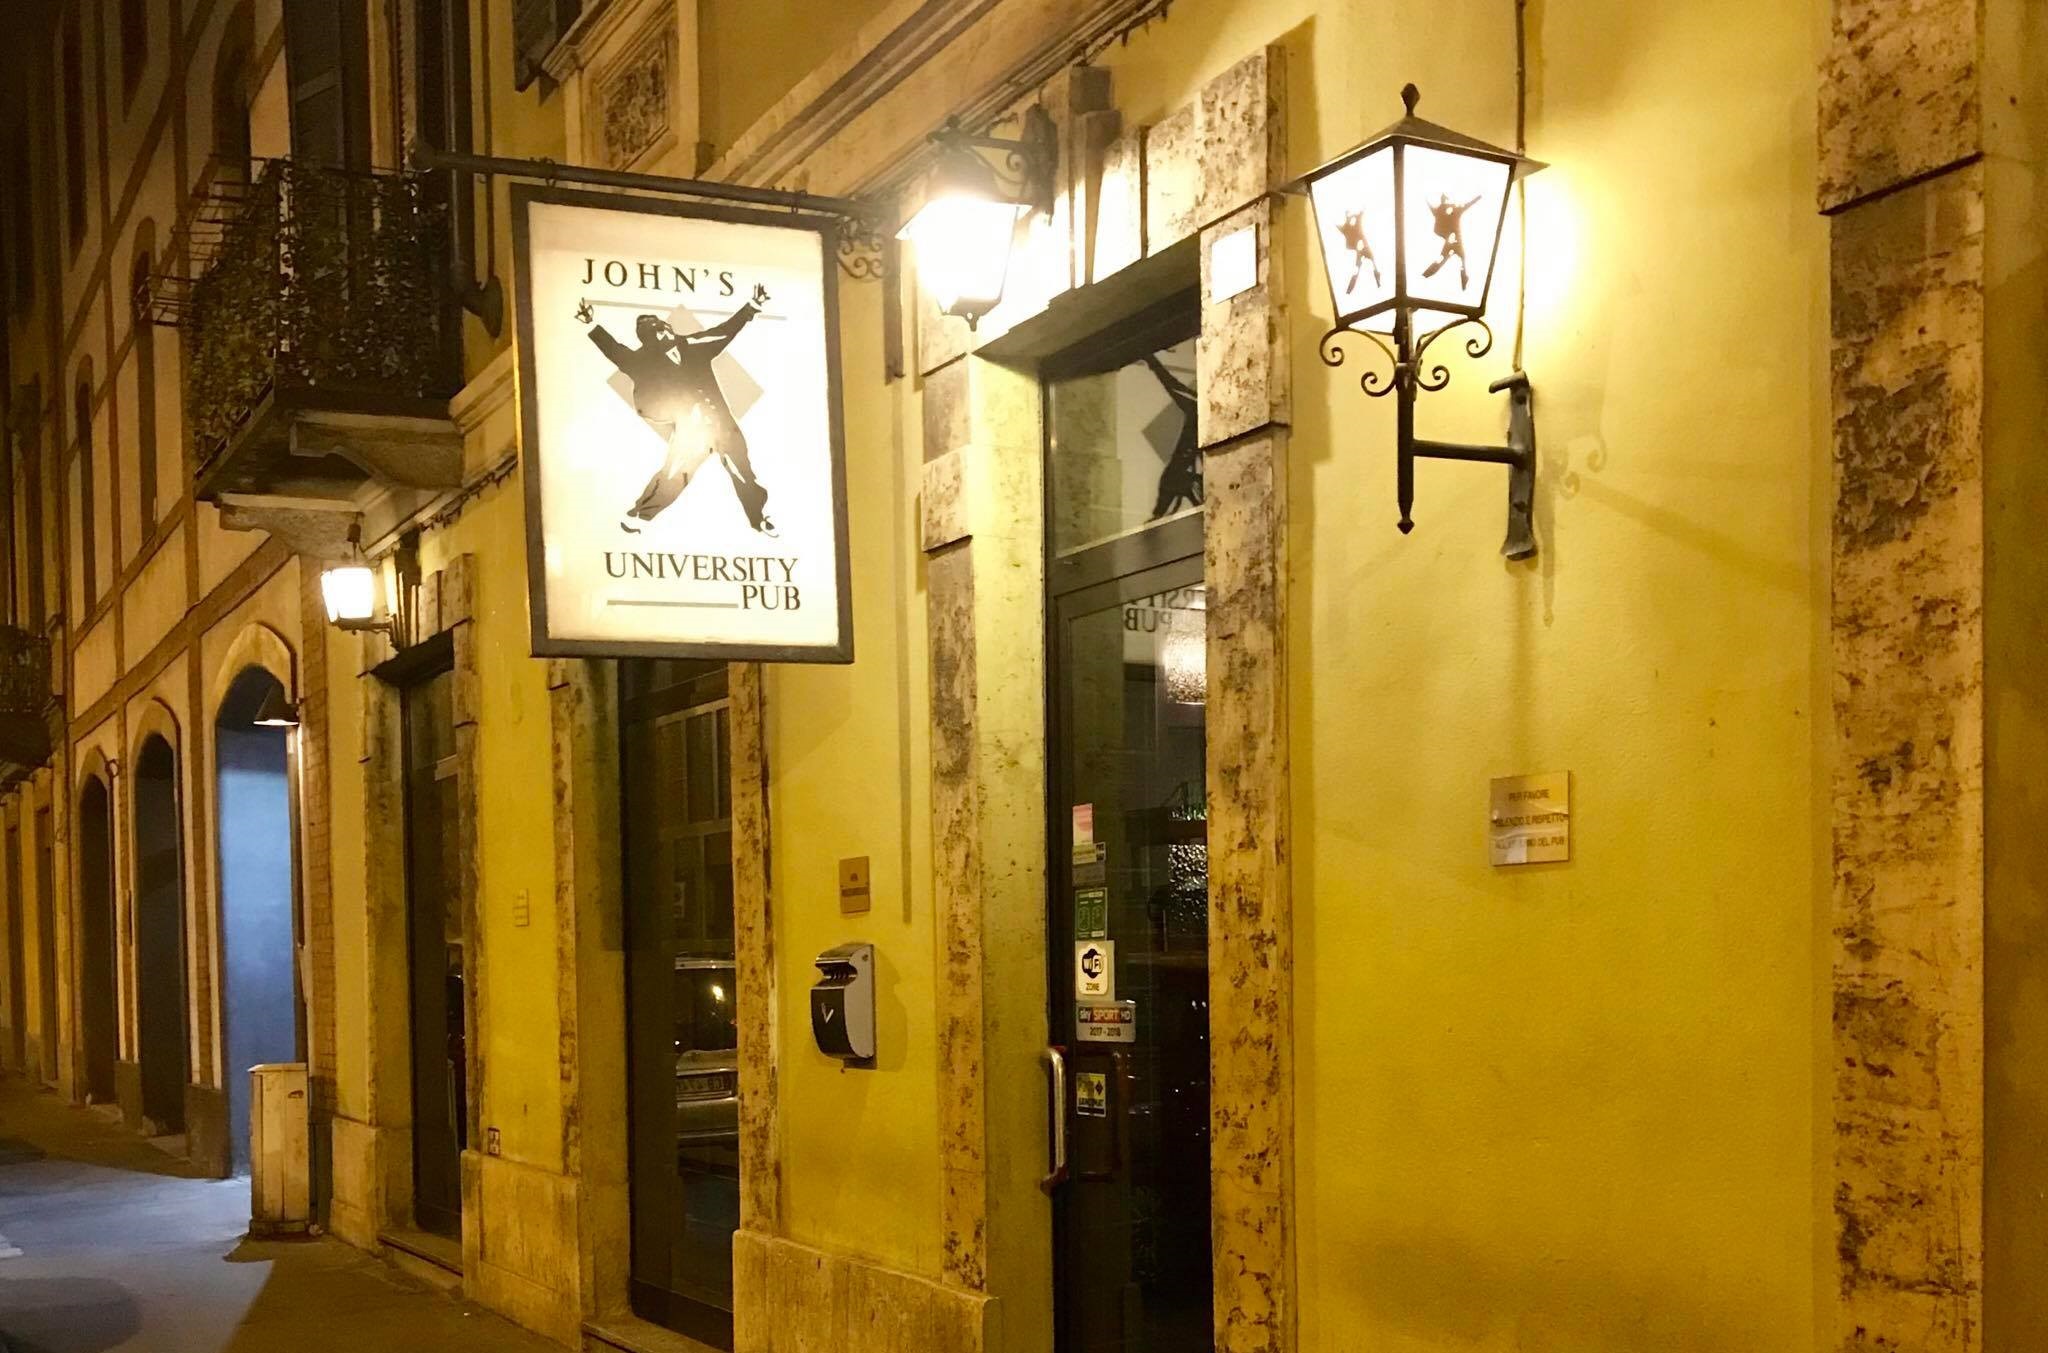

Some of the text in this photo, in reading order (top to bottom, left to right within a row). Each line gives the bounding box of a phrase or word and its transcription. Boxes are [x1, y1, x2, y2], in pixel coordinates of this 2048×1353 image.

[582, 258, 735, 297] JOHN'S
[604, 552, 798, 583] UNIVERSITY
[742, 585, 801, 611] PUB
[1093, 1009, 1119, 1021] SPORT
